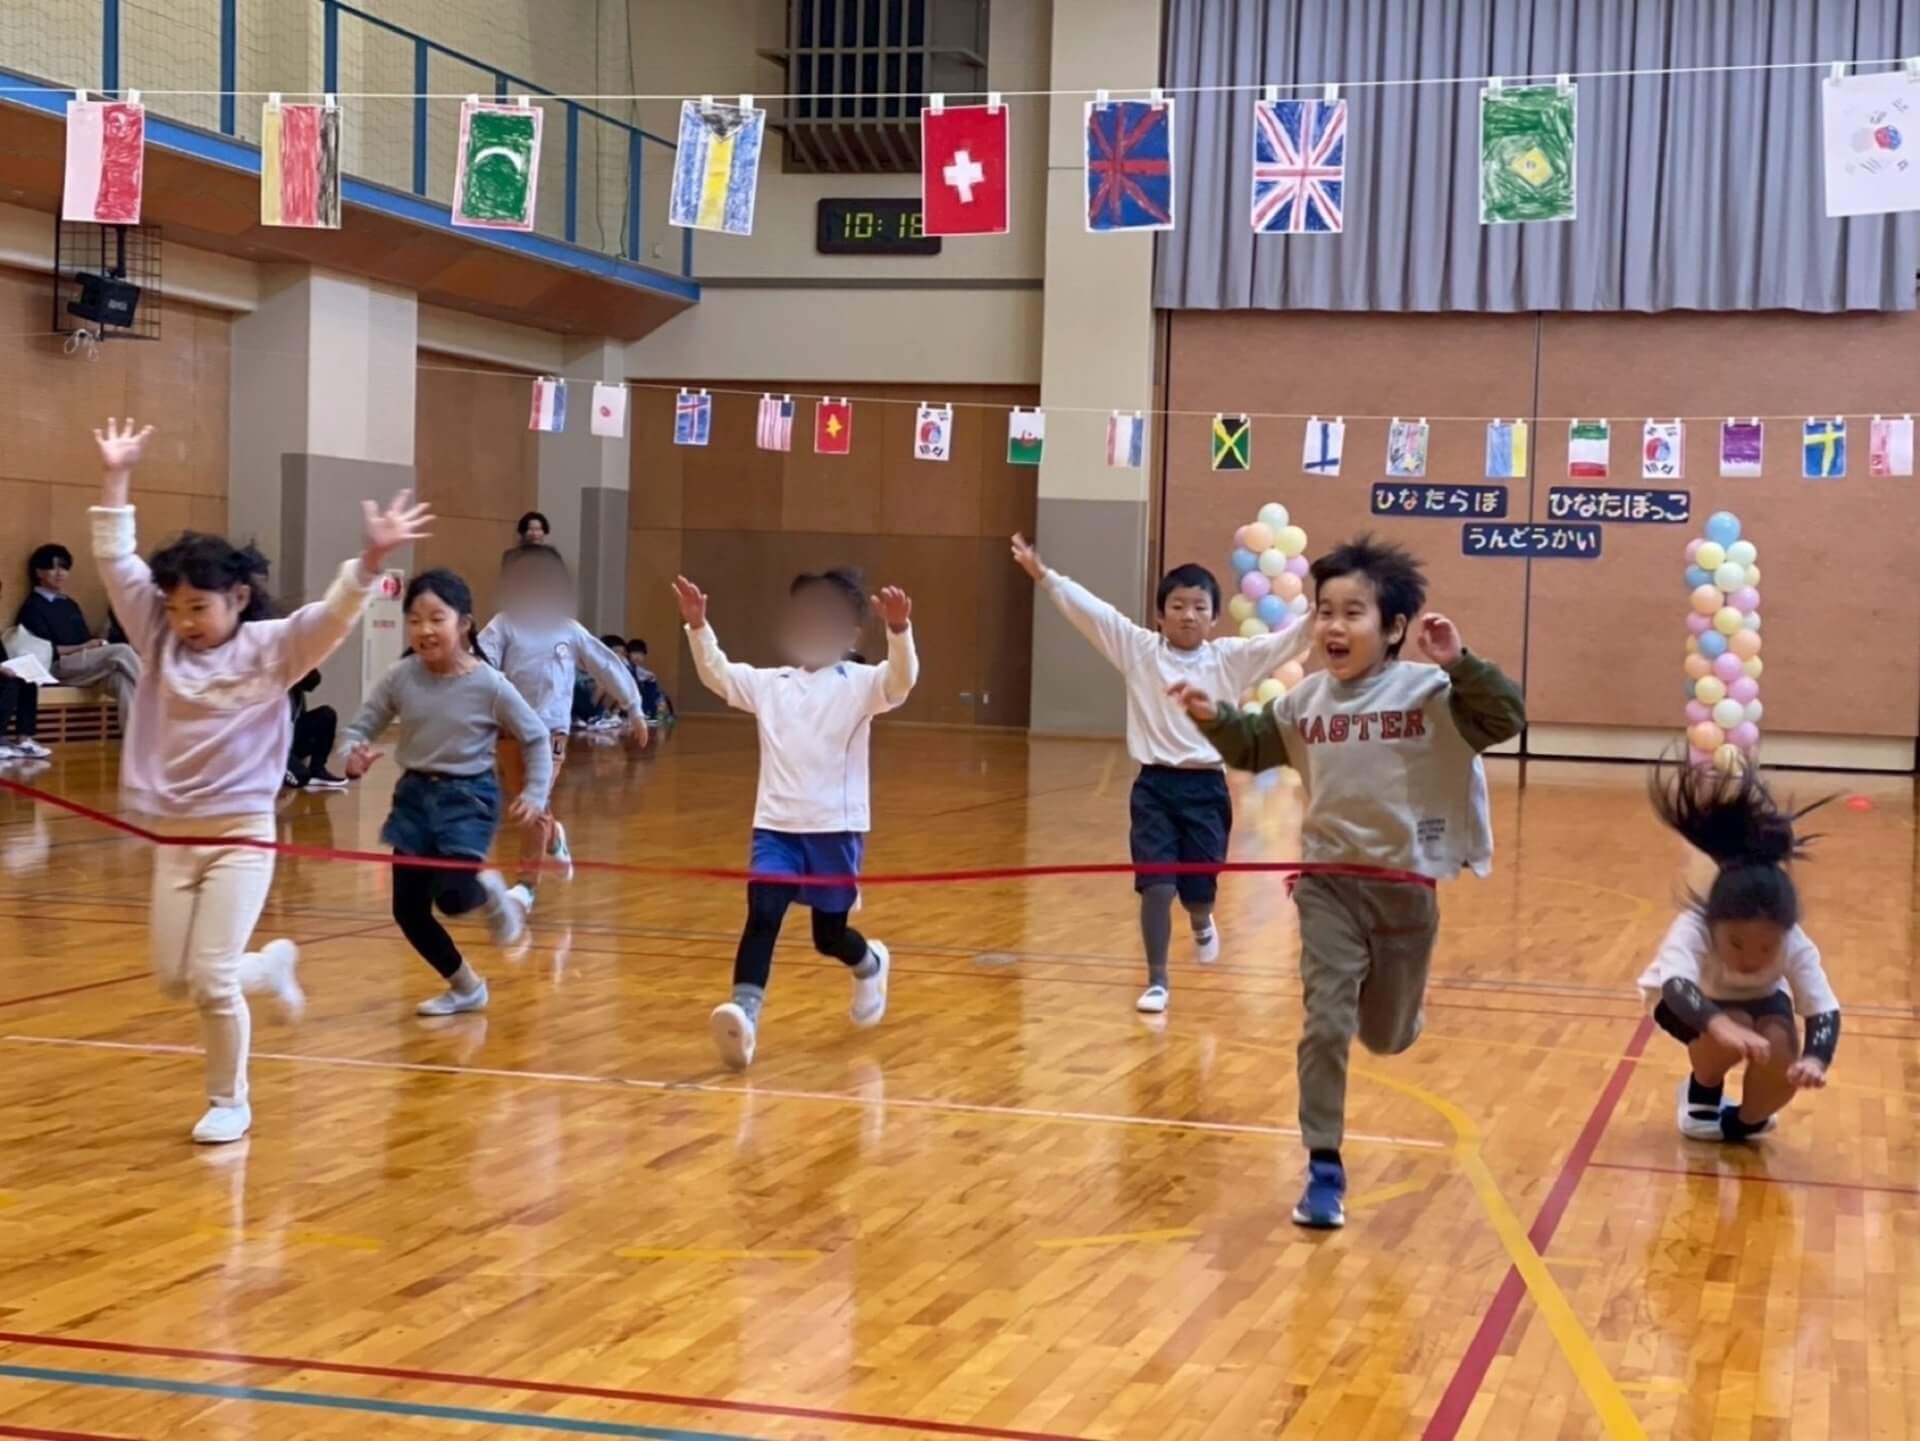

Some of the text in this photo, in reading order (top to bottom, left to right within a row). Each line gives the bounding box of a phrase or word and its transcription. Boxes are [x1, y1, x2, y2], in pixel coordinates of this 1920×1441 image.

[1376, 488, 1500, 513] ひなたらぼ
[1550, 491, 1689, 521] ひなたぼっこ
[1468, 526, 1597, 551] うんどうかい
